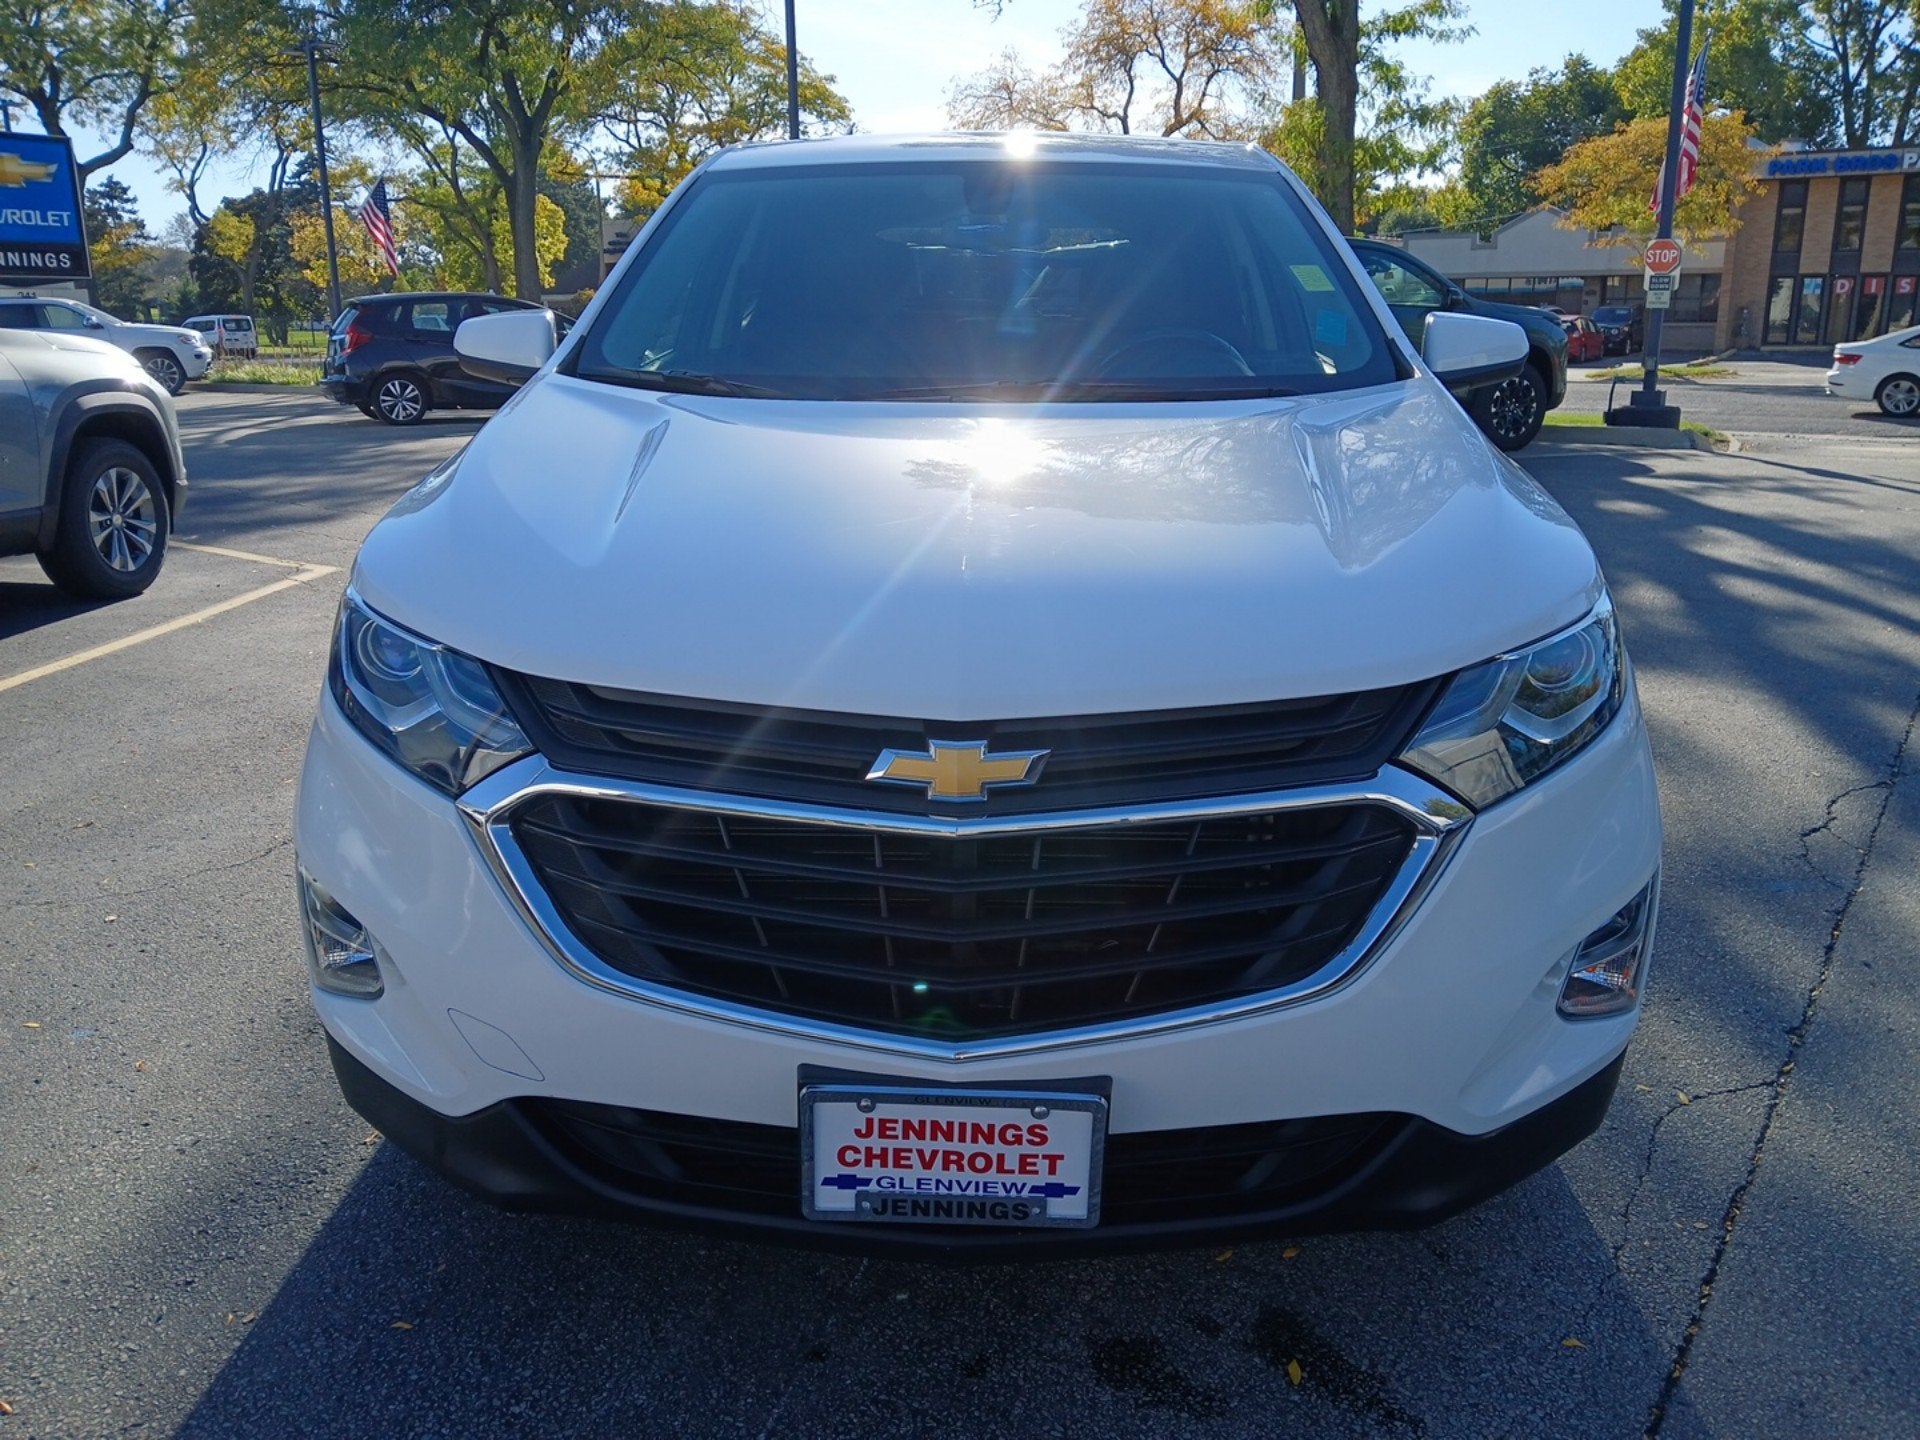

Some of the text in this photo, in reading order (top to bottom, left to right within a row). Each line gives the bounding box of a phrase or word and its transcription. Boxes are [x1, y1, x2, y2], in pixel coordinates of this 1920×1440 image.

[1646, 250, 1678, 263] STOP
[853, 1117, 1049, 1147] JENNINGS
[836, 1145, 1065, 1176] CHEVROLET
[875, 1175, 1028, 1195] GLENVIEW
[872, 1197, 1031, 1221] JENNINGS
